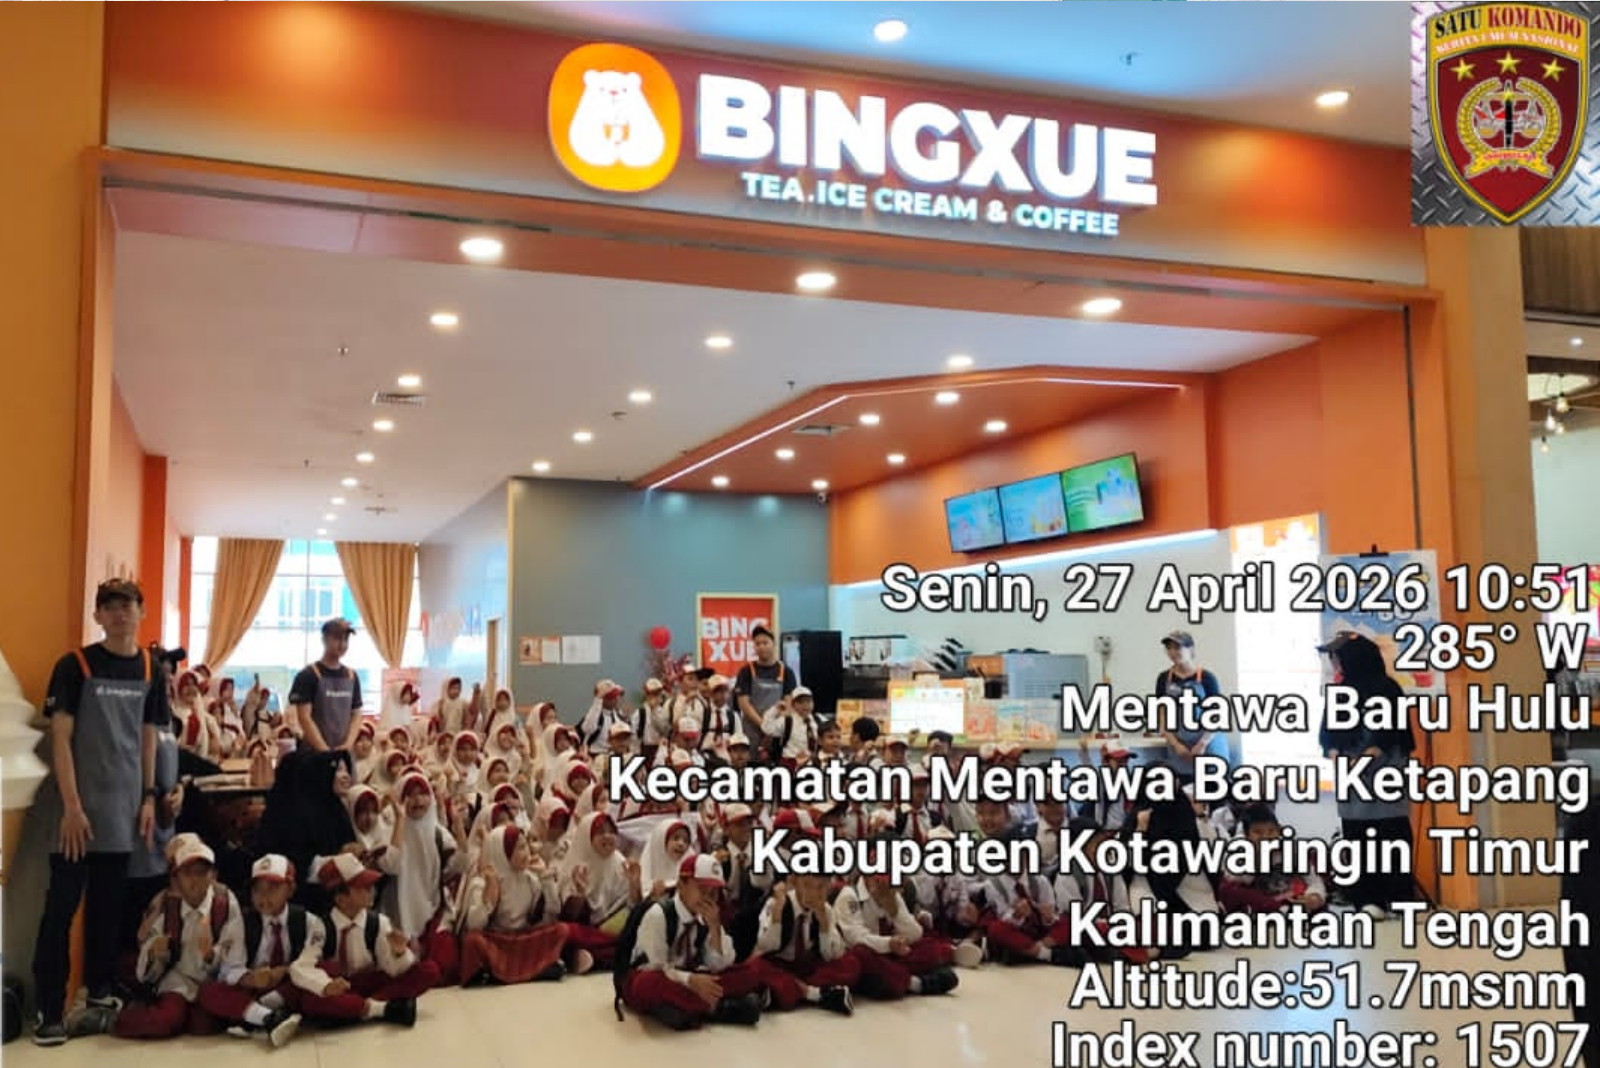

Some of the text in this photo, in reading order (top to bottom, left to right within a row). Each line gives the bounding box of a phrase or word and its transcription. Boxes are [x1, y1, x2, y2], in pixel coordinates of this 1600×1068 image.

[698, 74, 1157, 205] BINGXUE
[873, 186, 977, 222] CREAM
[985, 201, 1007, 223] &
[1014, 203, 1119, 237] COFFEE
